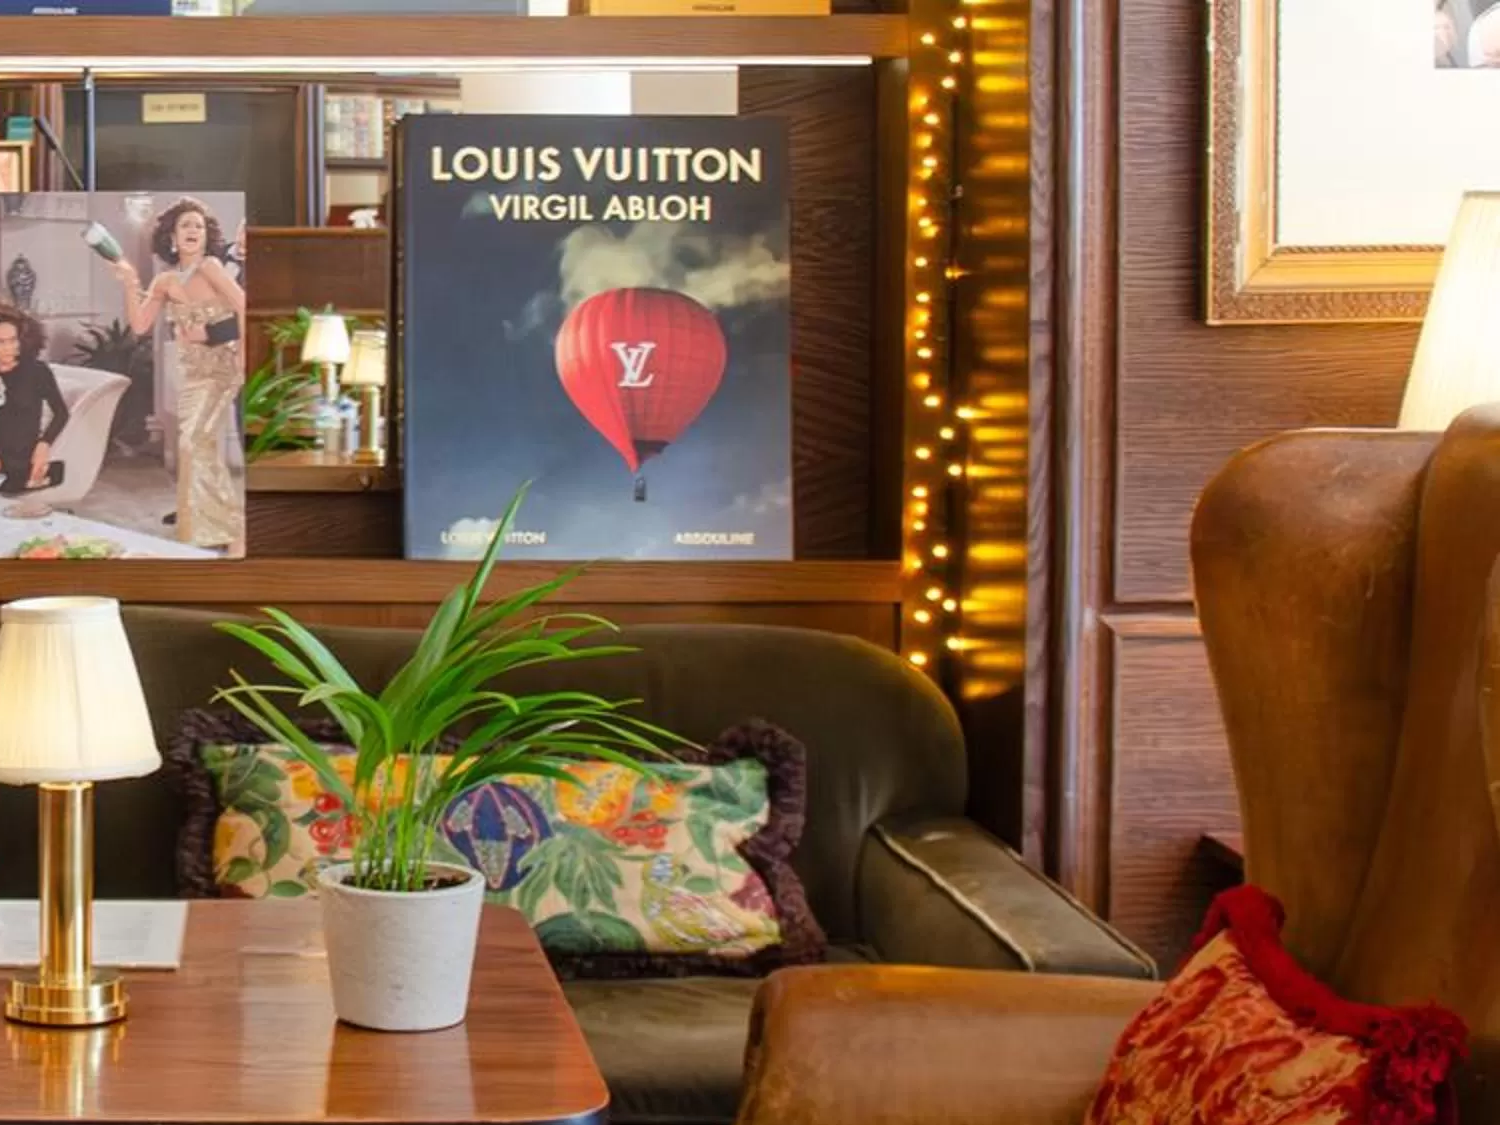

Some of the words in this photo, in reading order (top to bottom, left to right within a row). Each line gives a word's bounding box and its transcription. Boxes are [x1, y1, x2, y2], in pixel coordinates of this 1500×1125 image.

[431, 145, 562, 181] LOUIS
[572, 146, 763, 182] VUITTON
[489, 195, 593, 221] VIRGIL
[602, 195, 712, 221] ABLOH
